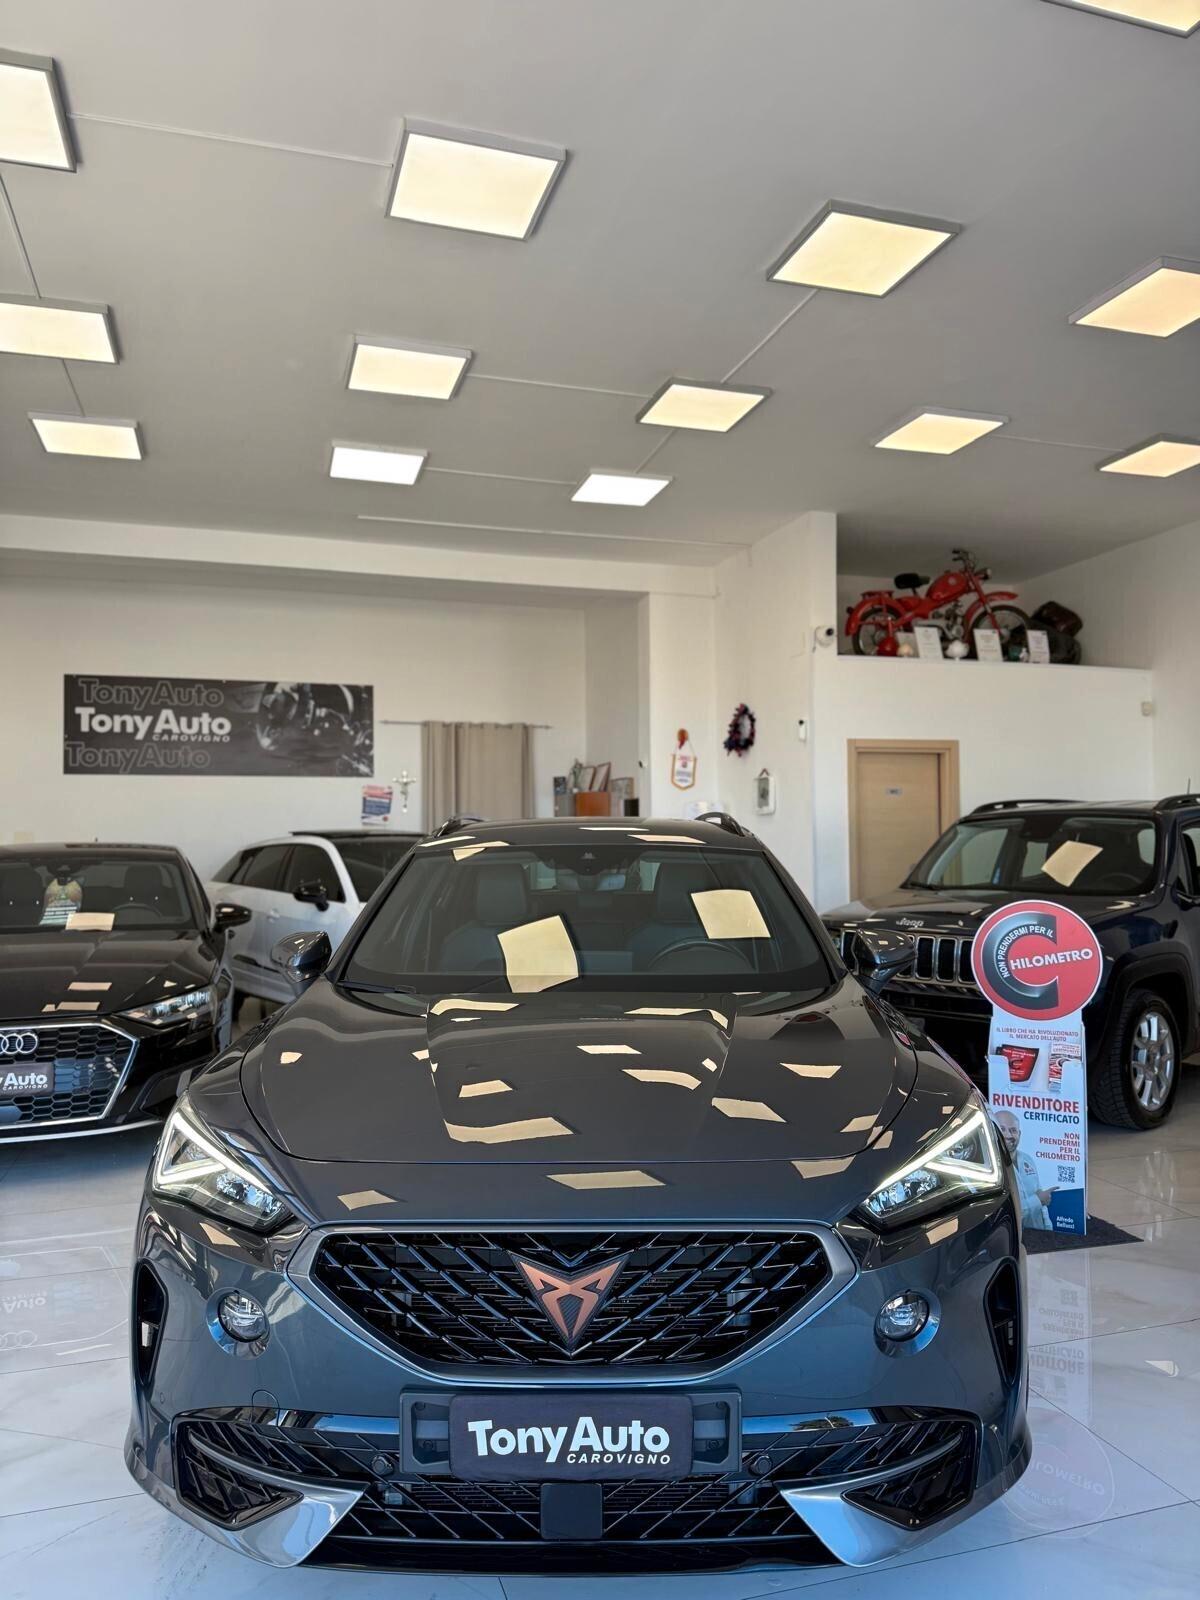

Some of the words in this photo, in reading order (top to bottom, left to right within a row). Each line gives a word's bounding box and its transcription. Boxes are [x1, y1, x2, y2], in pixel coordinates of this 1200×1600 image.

[152, 734, 231, 743] CAROVIGNO
[1029, 925, 1045, 934] PER
[1046, 930, 1054, 938] IL
[998, 925, 1029, 960] PRENDERMI
[998, 960, 1010, 978] NON
[992, 1093, 1079, 1113] RIVENDITORE
[1023, 1111, 1080, 1125] CERTIFICATO
[1064, 1132, 1080, 1140] NON
[1039, 1137, 1080, 1147] PRENDERMI
[1074, 1147, 1080, 1155] IL
[1035, 1151, 1080, 1162] CHILOMETRO
[566, 1453, 671, 1465] CAROVIGNO
